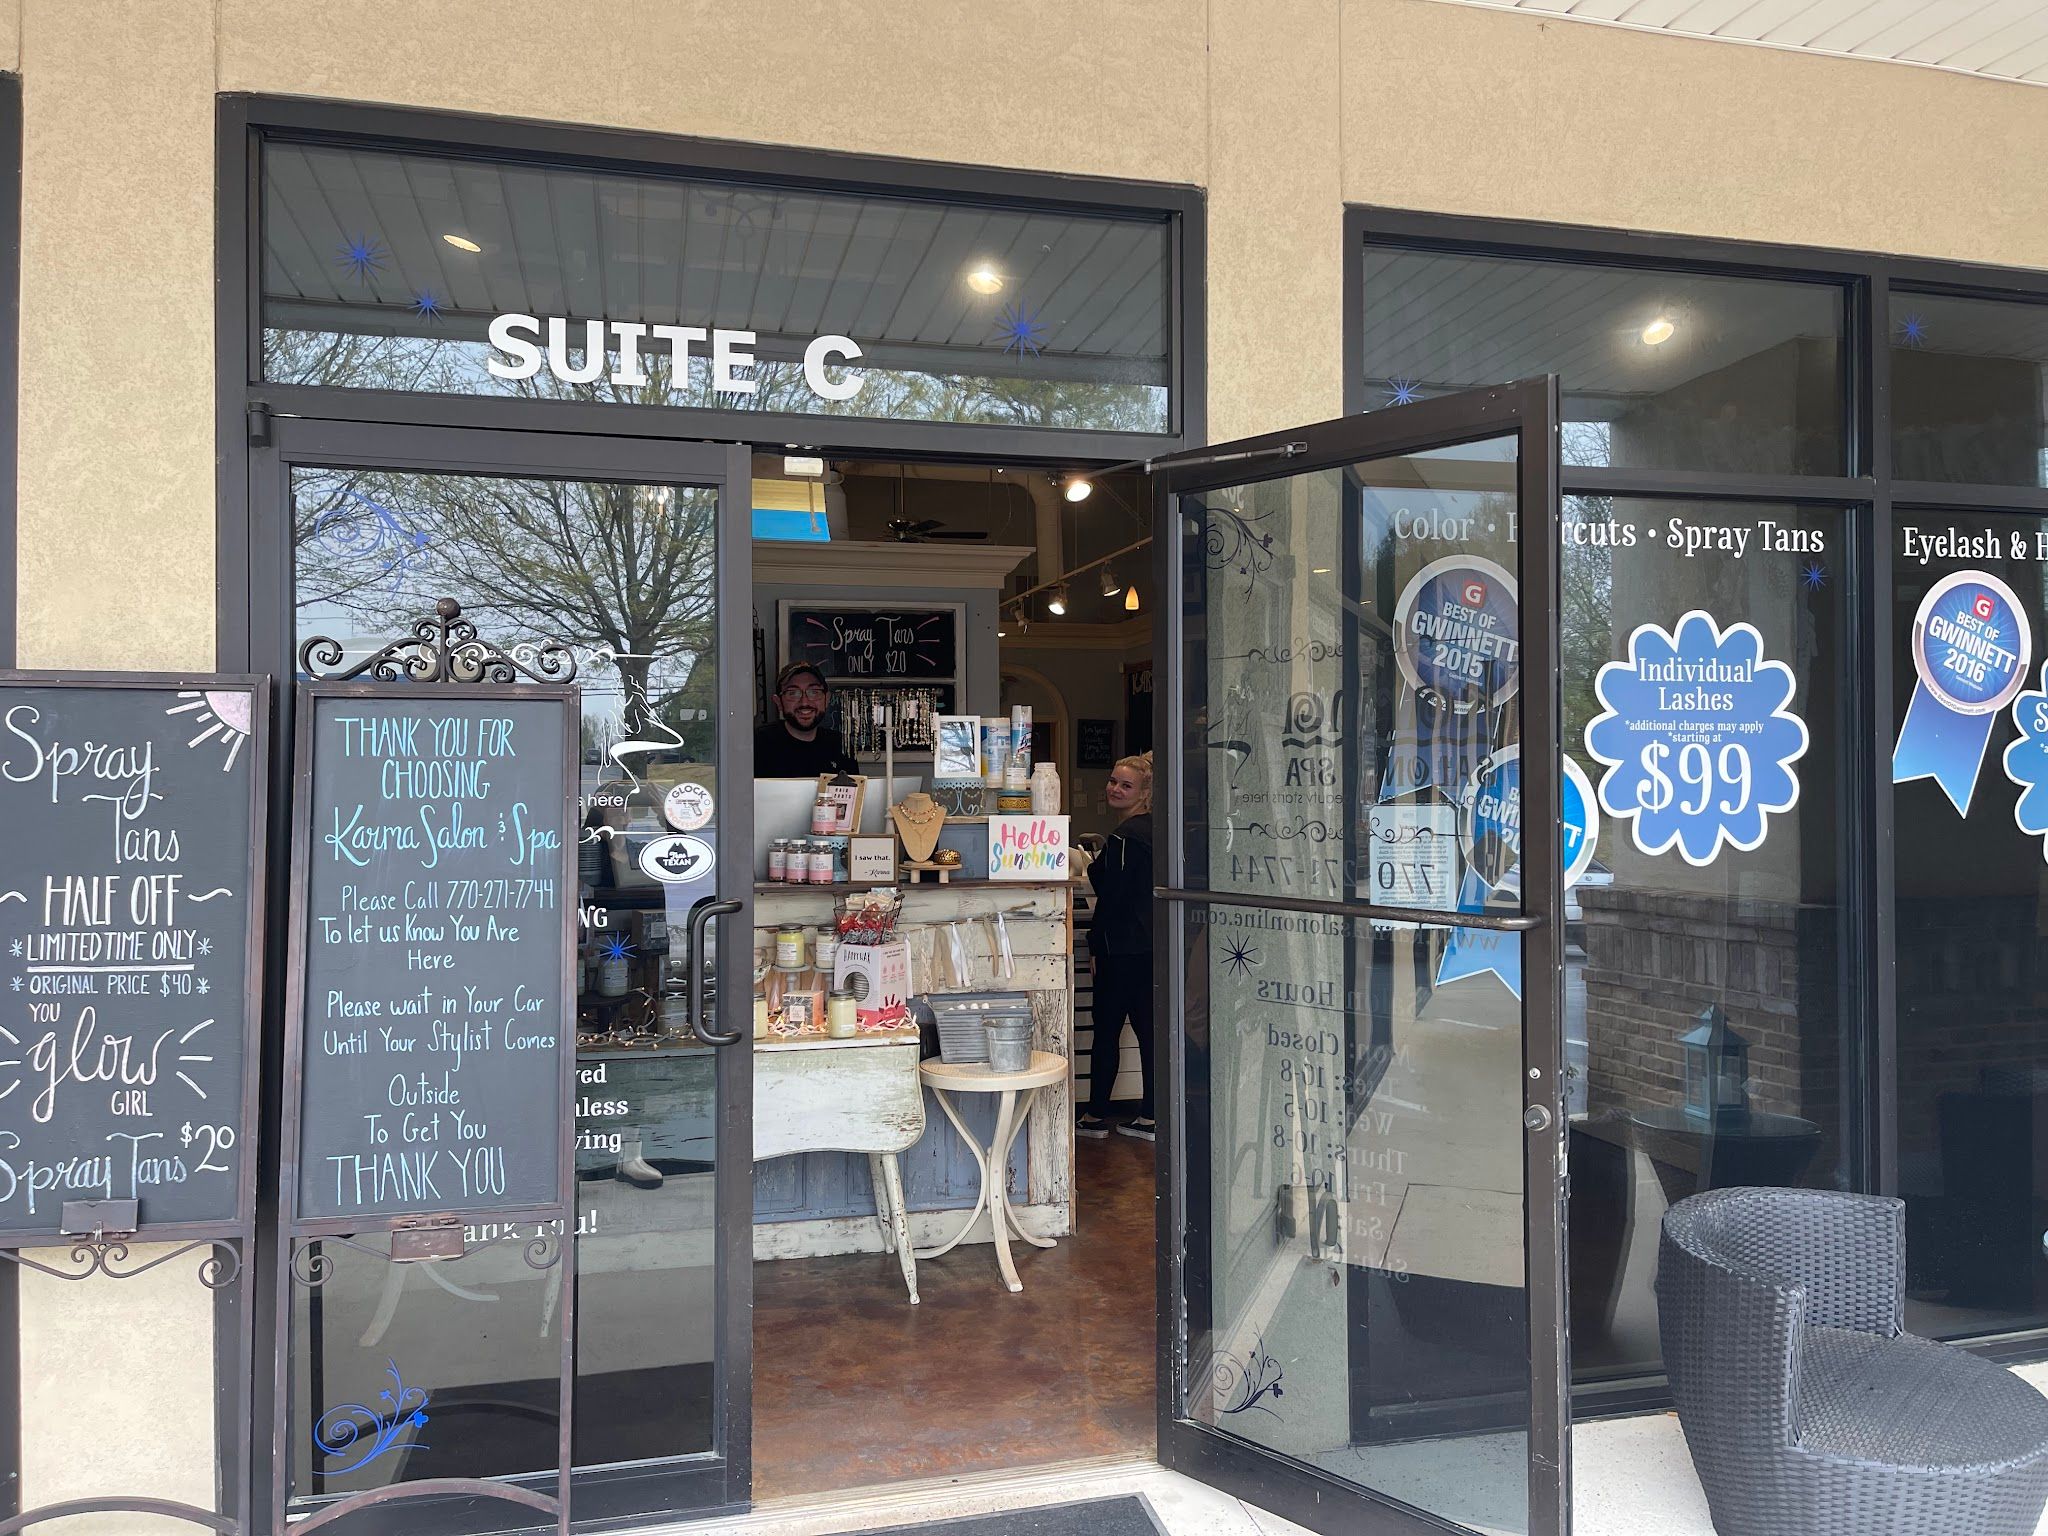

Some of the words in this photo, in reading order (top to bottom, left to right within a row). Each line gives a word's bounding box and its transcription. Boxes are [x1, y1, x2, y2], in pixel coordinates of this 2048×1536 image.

[487, 312, 757, 393] SUITE
[803, 334, 865, 401] C
[1394, 507, 1476, 542] Color
[1666, 517, 1751, 558] Spray
[1757, 520, 1825, 553] Tans
[1902, 525, 2003, 565] Eyelash
[2010, 531, 2027, 560] &
[1442, 601, 1479, 628] BEST
[1479, 612, 1497, 631] OF
[1956, 610, 1983, 633] BEST
[1984, 625, 2000, 642] OF
[831, 616, 876, 659] Spray
[875, 616, 915, 647] Tans
[1411, 610, 1519, 663] GWINNETT
[1929, 614, 2017, 675] GWINNETT
[848, 654, 874, 673] ONLY
[885, 650, 906, 673] $20
[1432, 644, 1484, 679] 2015
[1638, 656, 1754, 683] Individual
[1943, 647, 1986, 684] 2016
[1658, 686, 1734, 712] Lashes
[335, 717, 421, 757] THANK
[428, 717, 469, 757] YOU
[479, 718, 516, 757] FOR
[1678, 720, 1715, 734] charges
[1717, 722, 1737, 734] may
[1739, 720, 1765, 734] apply
[1712, 734, 1722, 743] at
[2, 705, 160, 820] Spray
[381, 759, 490, 799] CHOOSING
[1636, 740, 1752, 816] $99
[588, 794, 624, 807] here
[671, 785, 708, 800] GLOCK
[82, 793, 180, 864] Tans
[324, 804, 420, 867] Karma
[419, 801, 488, 868] Salon
[510, 802, 562, 866] Spa
[1000, 818, 1062, 850] Hello
[662, 858, 692, 867] TEXAN
[990, 841, 1067, 873] Sunshine
[45, 875, 121, 926] HALF
[131, 874, 183, 926] OFF
[342, 884, 397, 911] Please
[404, 880, 439, 909] Call
[446, 878, 554, 909] 770-271-7744
[152, 930, 197, 960] ONLY
[318, 916, 342, 944] To
[348, 914, 373, 943] let
[379, 925, 400, 942] us
[405, 913, 445, 942] Know
[450, 914, 480, 942] You
[486, 915, 520, 942] Are
[407, 949, 456, 970] Here
[29, 975, 98, 995] ORIGINAL
[107, 975, 150, 995] PRICE
[160, 972, 192, 997] $40
[327, 990, 382, 1018] Please
[389, 985, 433, 1016] wait
[442, 995, 457, 1015] in
[463, 985, 504, 1015] Your
[514, 984, 545, 1013] Car
[29, 1003, 61, 1022] YOU
[323, 1029, 367, 1056] Until
[378, 1026, 417, 1053] Your
[427, 1019, 493, 1073] Stylist
[504, 1017, 556, 1050] Comes
[26, 1006, 174, 1122] glow
[111, 1091, 153, 1116] GIRL
[388, 1070, 461, 1107] Outside
[364, 1114, 389, 1145] To
[402, 1112, 441, 1143] Get
[449, 1109, 487, 1140] You
[106, 1132, 187, 1199] Tans
[180, 1122, 235, 1172] $20
[326, 1150, 441, 1206] THANK
[448, 1146, 506, 1197] YOU
